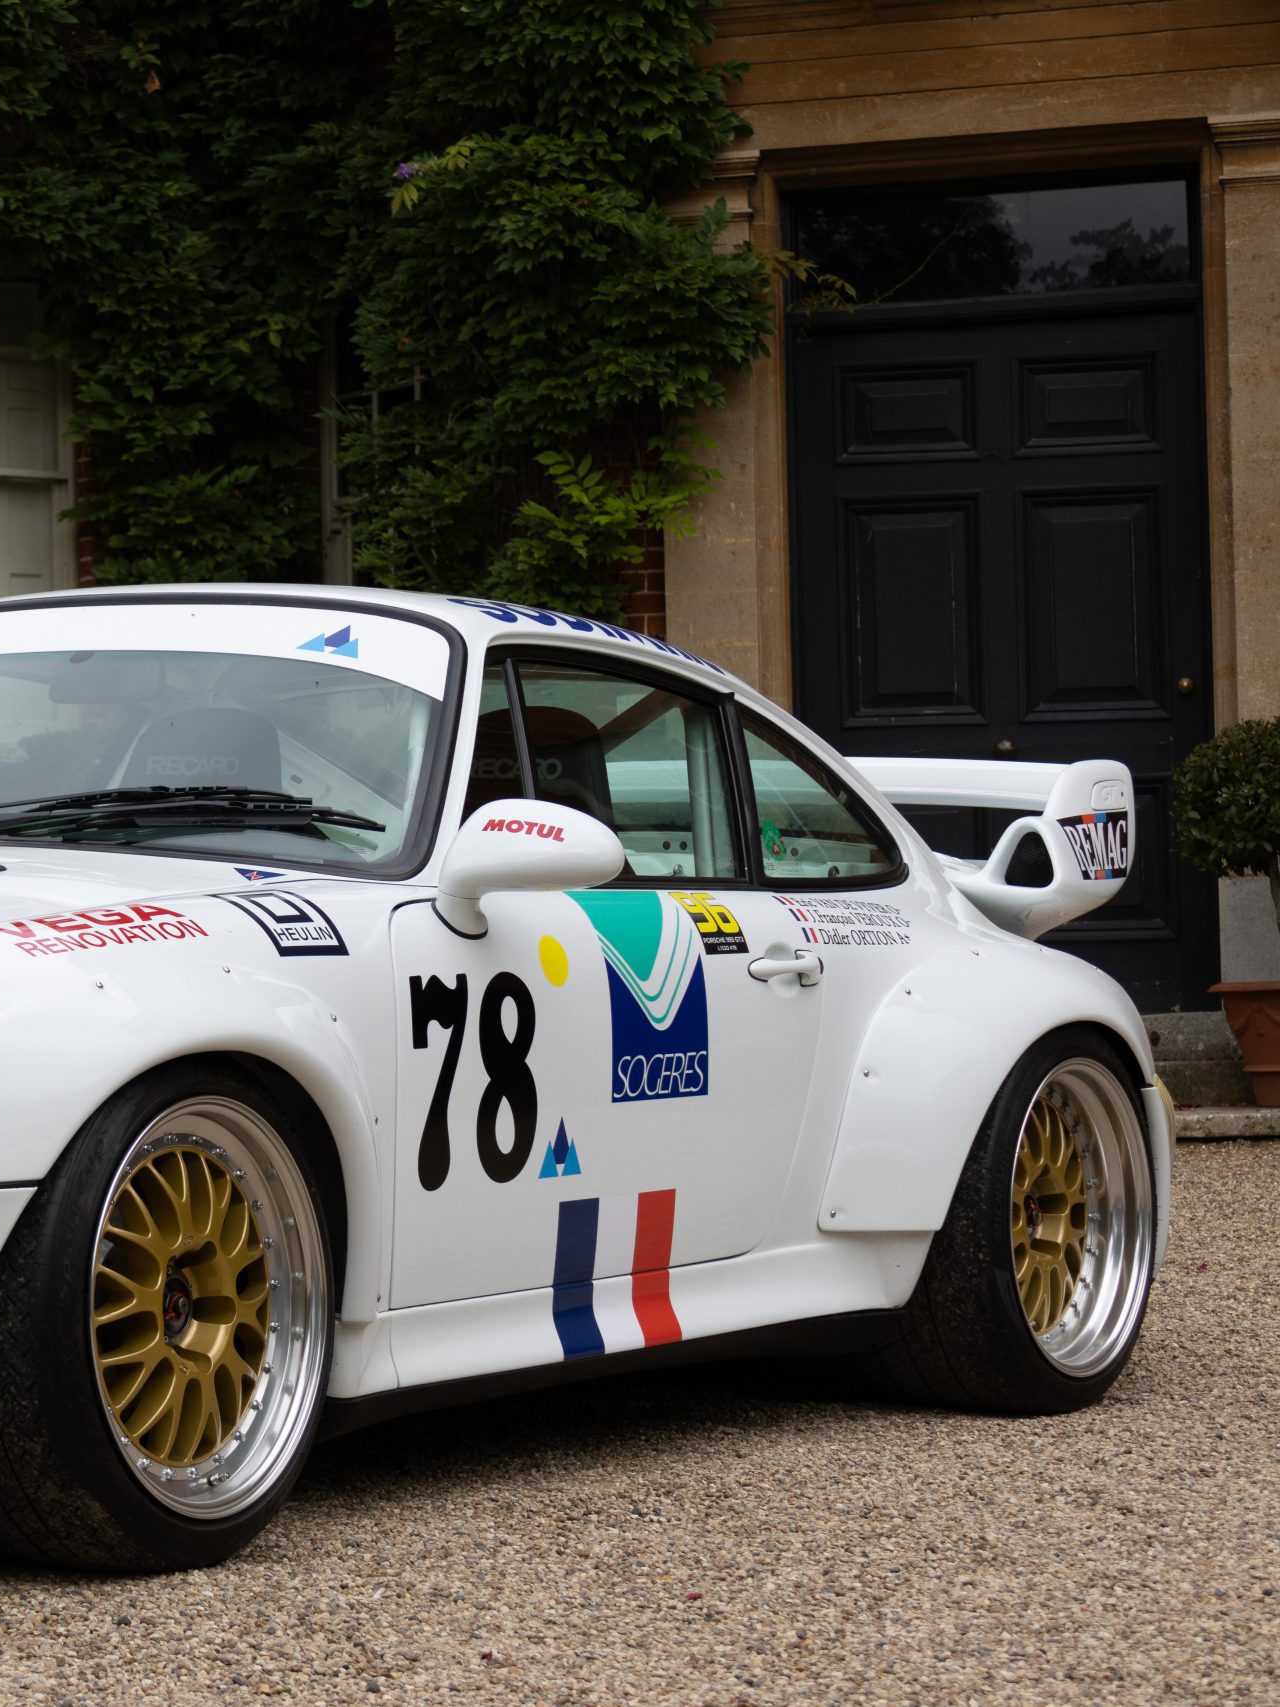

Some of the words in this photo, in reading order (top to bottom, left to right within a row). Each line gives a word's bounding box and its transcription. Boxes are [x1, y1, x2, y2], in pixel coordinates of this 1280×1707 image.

[145, 756, 239, 776] RECARO
[482, 818, 566, 842] MOTUL
[1063, 819, 1127, 872] REMAG
[668, 892, 740, 934] 96
[14, 919, 210, 957] RENOVATION
[274, 925, 335, 943] HEULIN
[850, 929, 900, 946] ORTION
[408, 971, 538, 1192] 78
[613, 1050, 708, 1098] SOGERES
